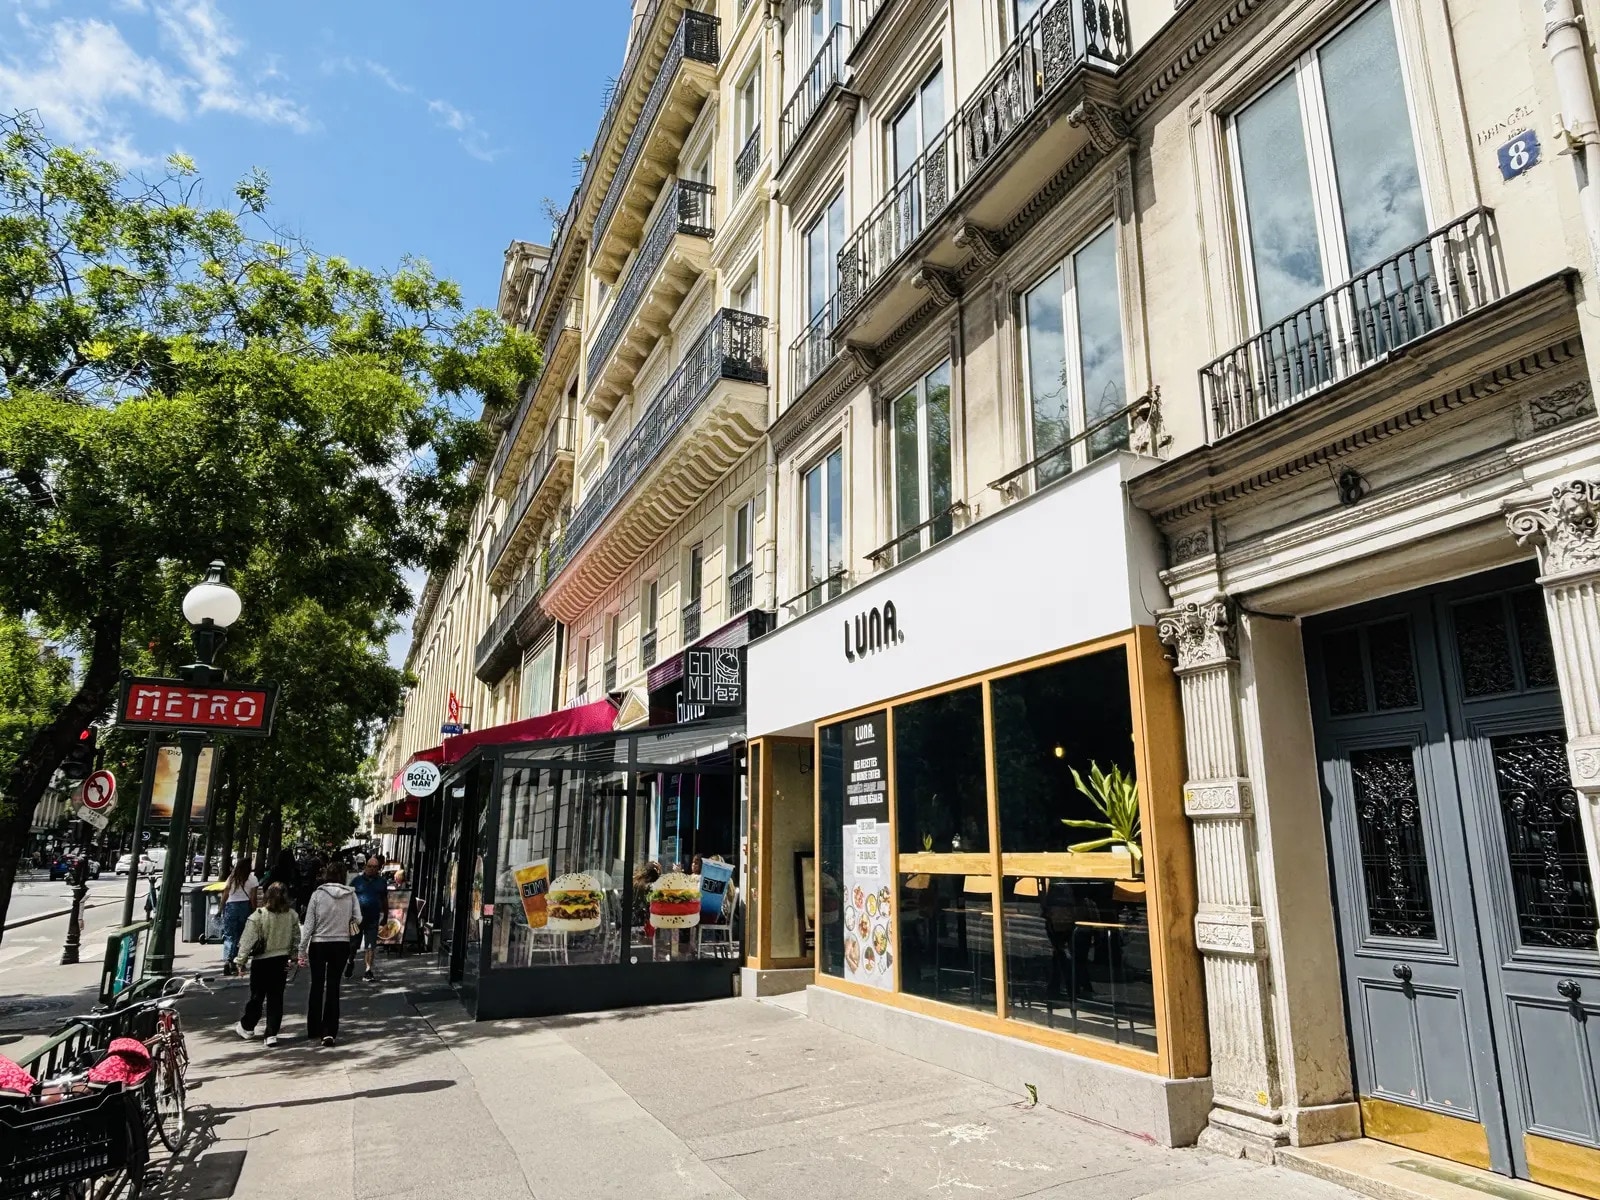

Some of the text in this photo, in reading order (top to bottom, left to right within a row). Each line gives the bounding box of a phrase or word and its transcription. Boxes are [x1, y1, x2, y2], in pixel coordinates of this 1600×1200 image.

[1508, 140, 1529, 170] 8
[688, 651, 711, 676] GO
[688, 676, 711, 701] MU
[714, 685, 739, 701] 包子
[134, 689, 256, 722] METRO
[407, 773, 437, 782] BOLLY
[411, 780, 431, 788] NAN
